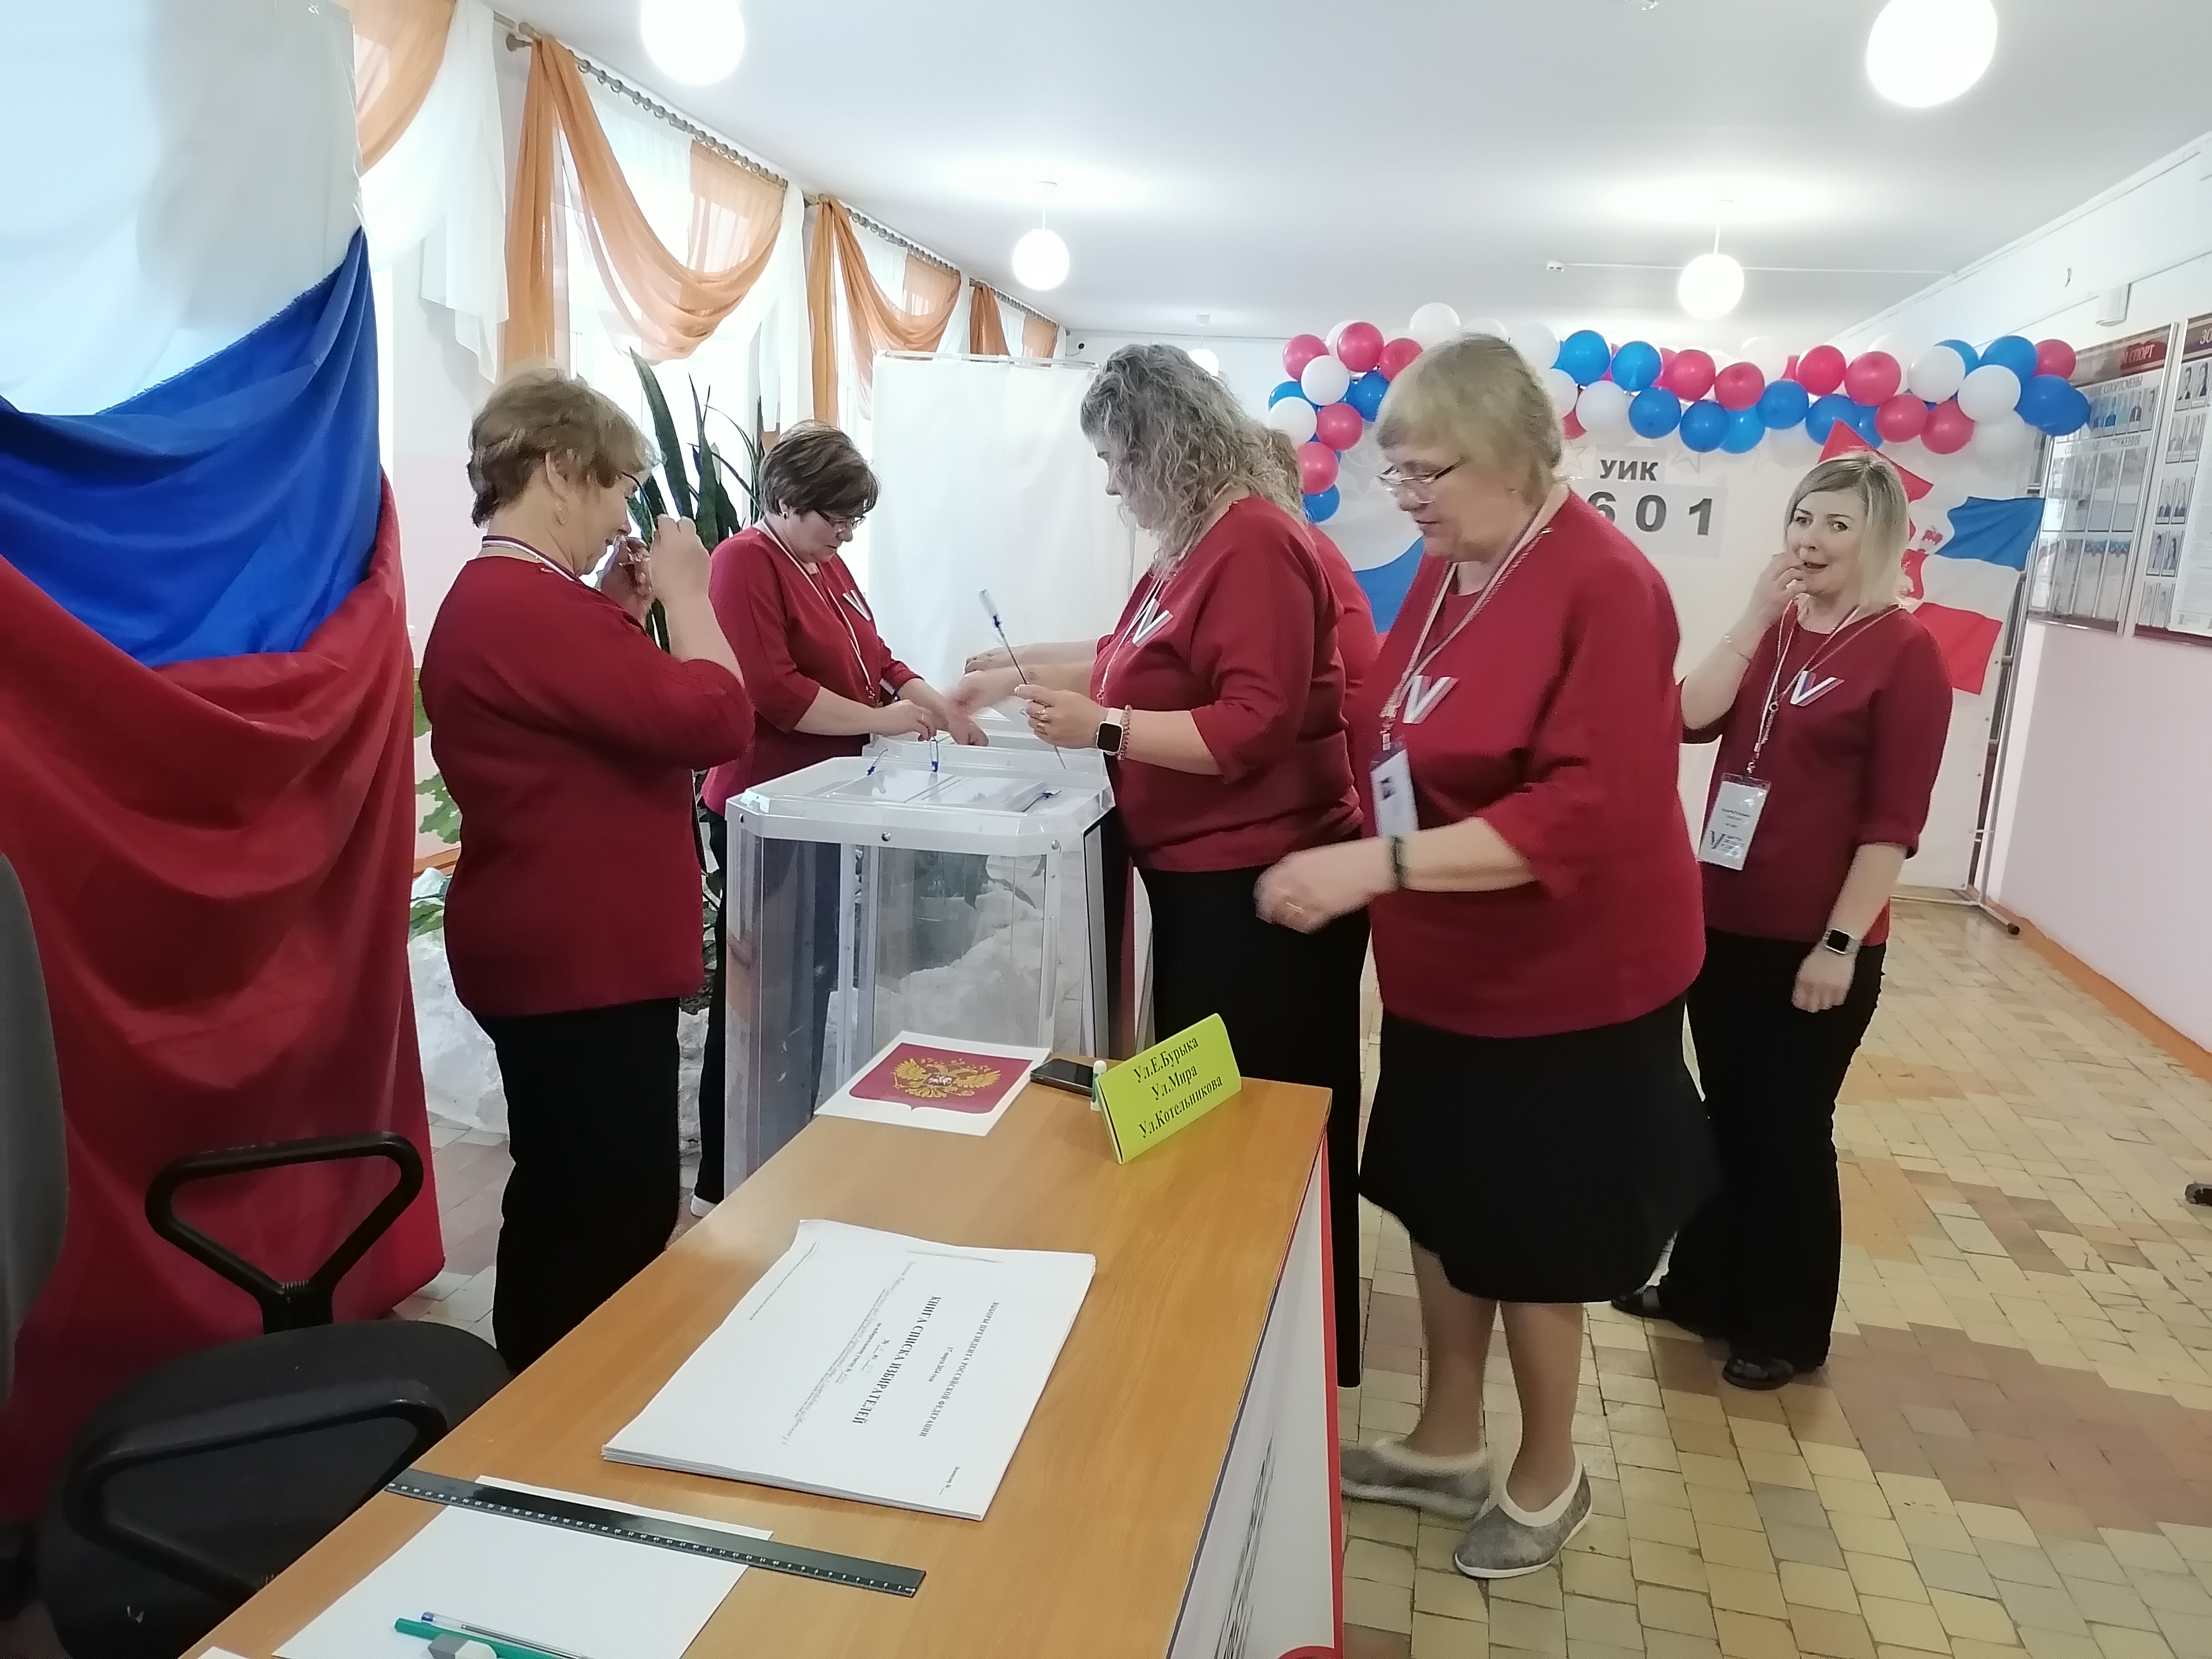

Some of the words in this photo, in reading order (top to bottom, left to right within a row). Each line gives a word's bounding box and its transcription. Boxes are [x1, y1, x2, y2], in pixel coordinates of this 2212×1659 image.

[2129, 344, 2155, 363] СПОРТ
[1599, 459, 1658, 481] УИК
[1133, 1037, 1199, 1083] Ул.Е.Бурыка
[1151, 1065, 1198, 1100] Ул.Мира
[1138, 1076, 1223, 1139] Ул.Котельникова
[917, 1296, 941, 1323] КНИГА
[983, 1302, 999, 1324] ВЫБОРЫ
[895, 1326, 923, 1360] СПИСКА
[963, 1324, 987, 1360] ПРЕЗИДЕНТА
[853, 1363, 901, 1423] ИЗБИРАТЕЛЕЙ
[941, 1363, 967, 1400] РОССИЙСКОЙ
[920, 1401, 945, 1437] ФЕДЕРАЦИИ
